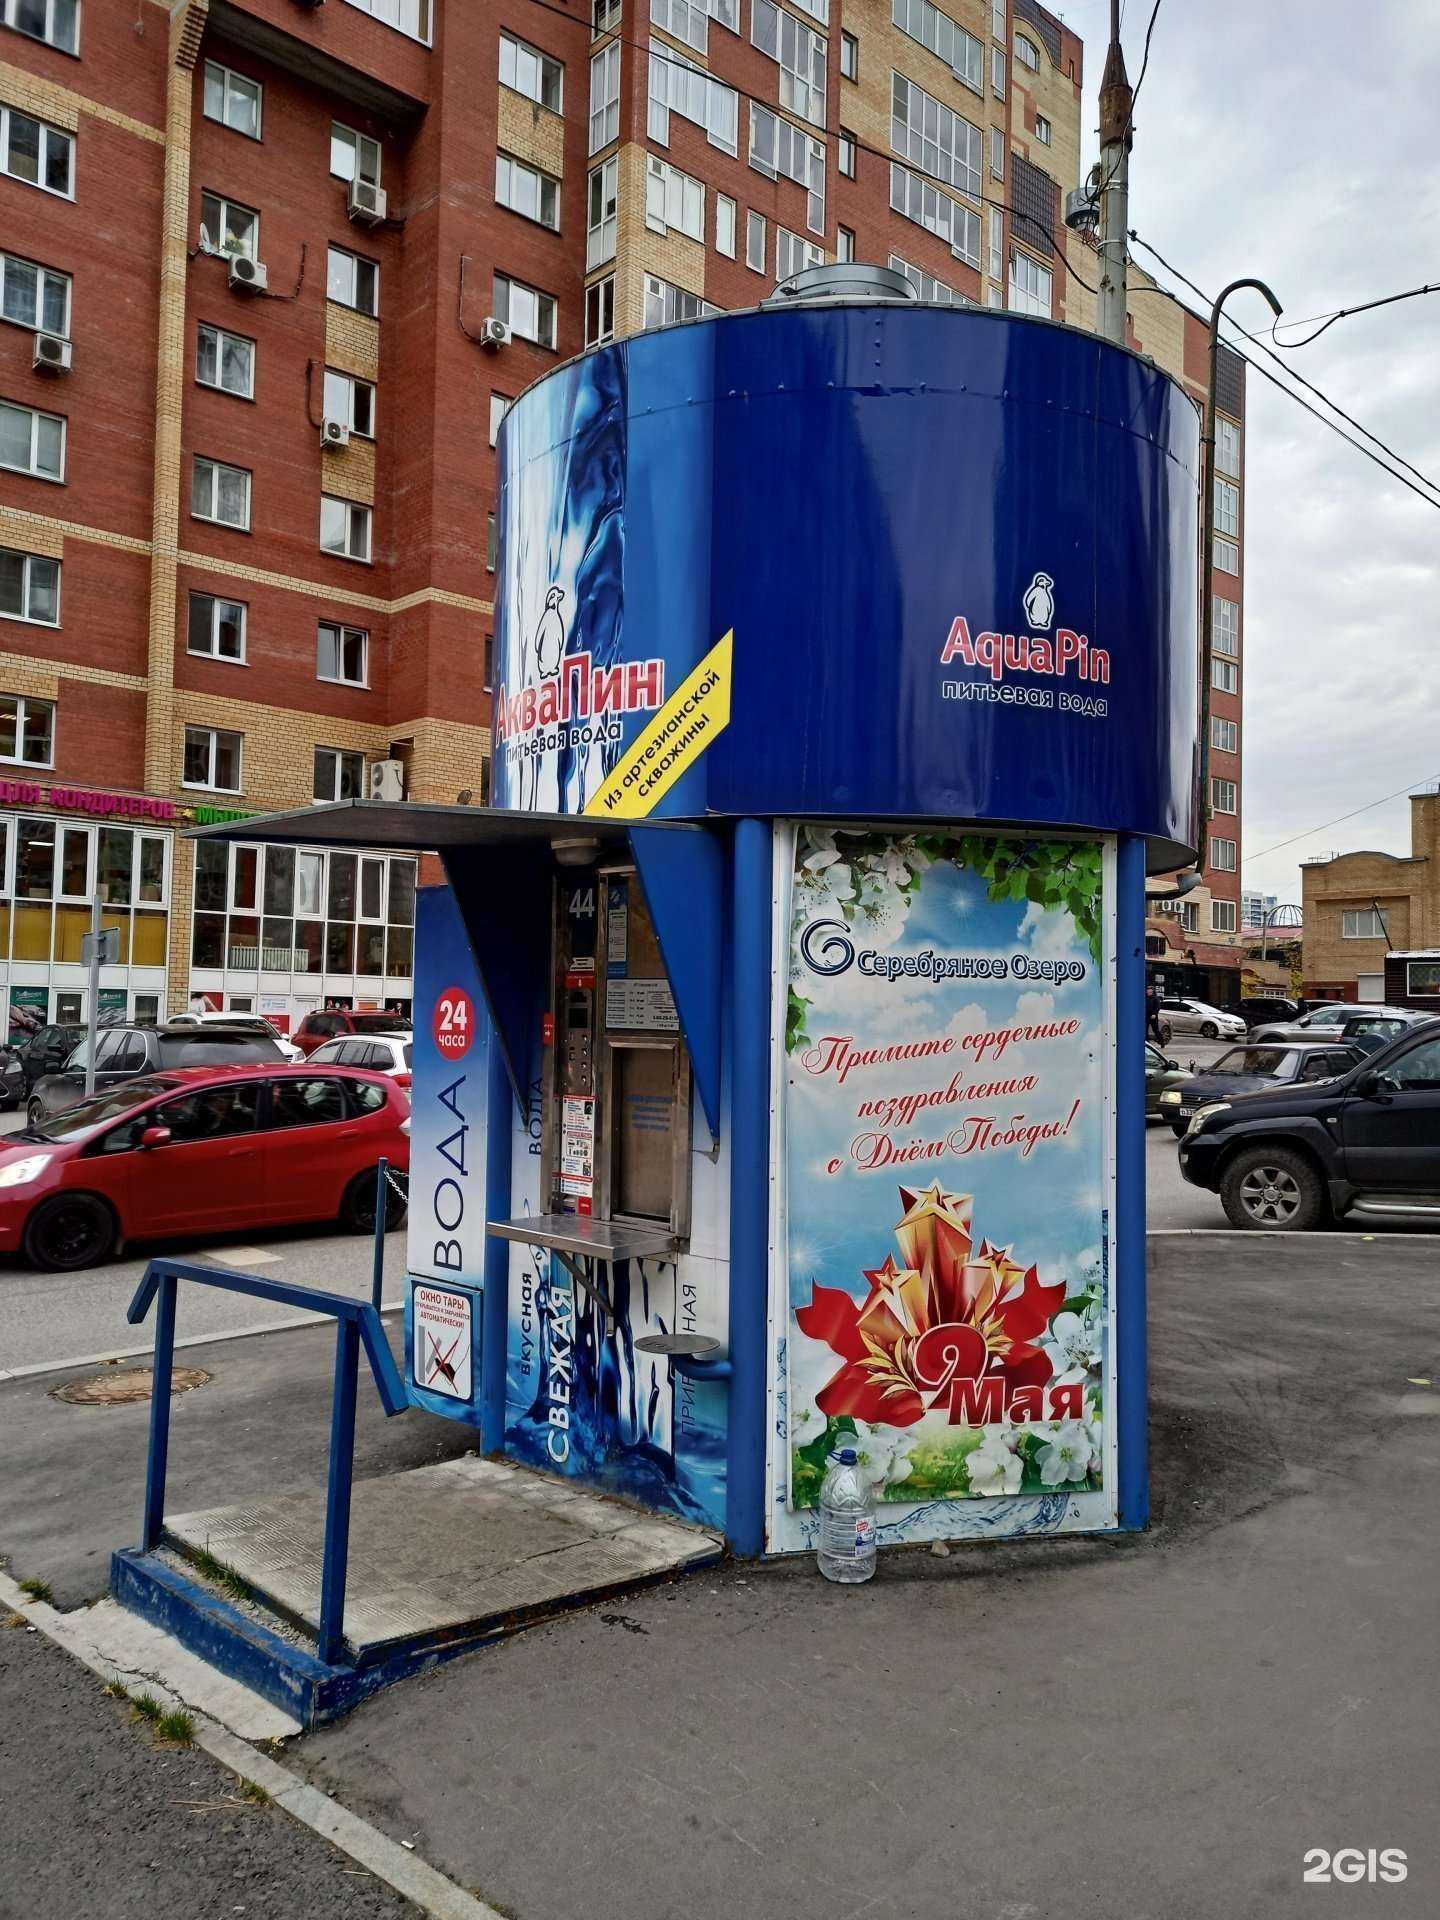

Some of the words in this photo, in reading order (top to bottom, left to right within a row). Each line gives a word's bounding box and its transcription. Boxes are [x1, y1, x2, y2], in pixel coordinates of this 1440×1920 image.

[941, 617, 1110, 684] AquaPin
[496, 652, 664, 746] АкваПин
[942, 681, 1054, 708] питьевая
[1059, 692, 1108, 716] вода
[506, 731, 565, 764] питьевая
[571, 723, 621, 743] вода
[604, 789, 622, 810] Из
[622, 668, 720, 788] артезианской
[638, 712, 711, 798] скважины
[568, 887, 595, 919] 44
[858, 950, 1007, 982] Серебряное
[1010, 954, 1086, 985] Озеро
[438, 1034, 465, 1047] часа
[439, 999, 467, 1031] 24
[801, 1036, 956, 1084] Примите
[961, 1017, 1081, 1062] сердечные
[858, 1071, 1039, 1128] поздравления
[827, 1157, 842, 1174] с
[851, 1132, 948, 1170] Днём
[948, 1098, 1081, 1156] Победы!
[434, 1075, 469, 1272] ВОДА
[420, 1290, 441, 1304] ОКНО
[443, 1295, 464, 1310] ТАРЫ
[548, 1286, 572, 1464] СВЕЖАЯ
[913, 1322, 989, 1410] 9
[947, 1376, 1085, 1426] Мая
